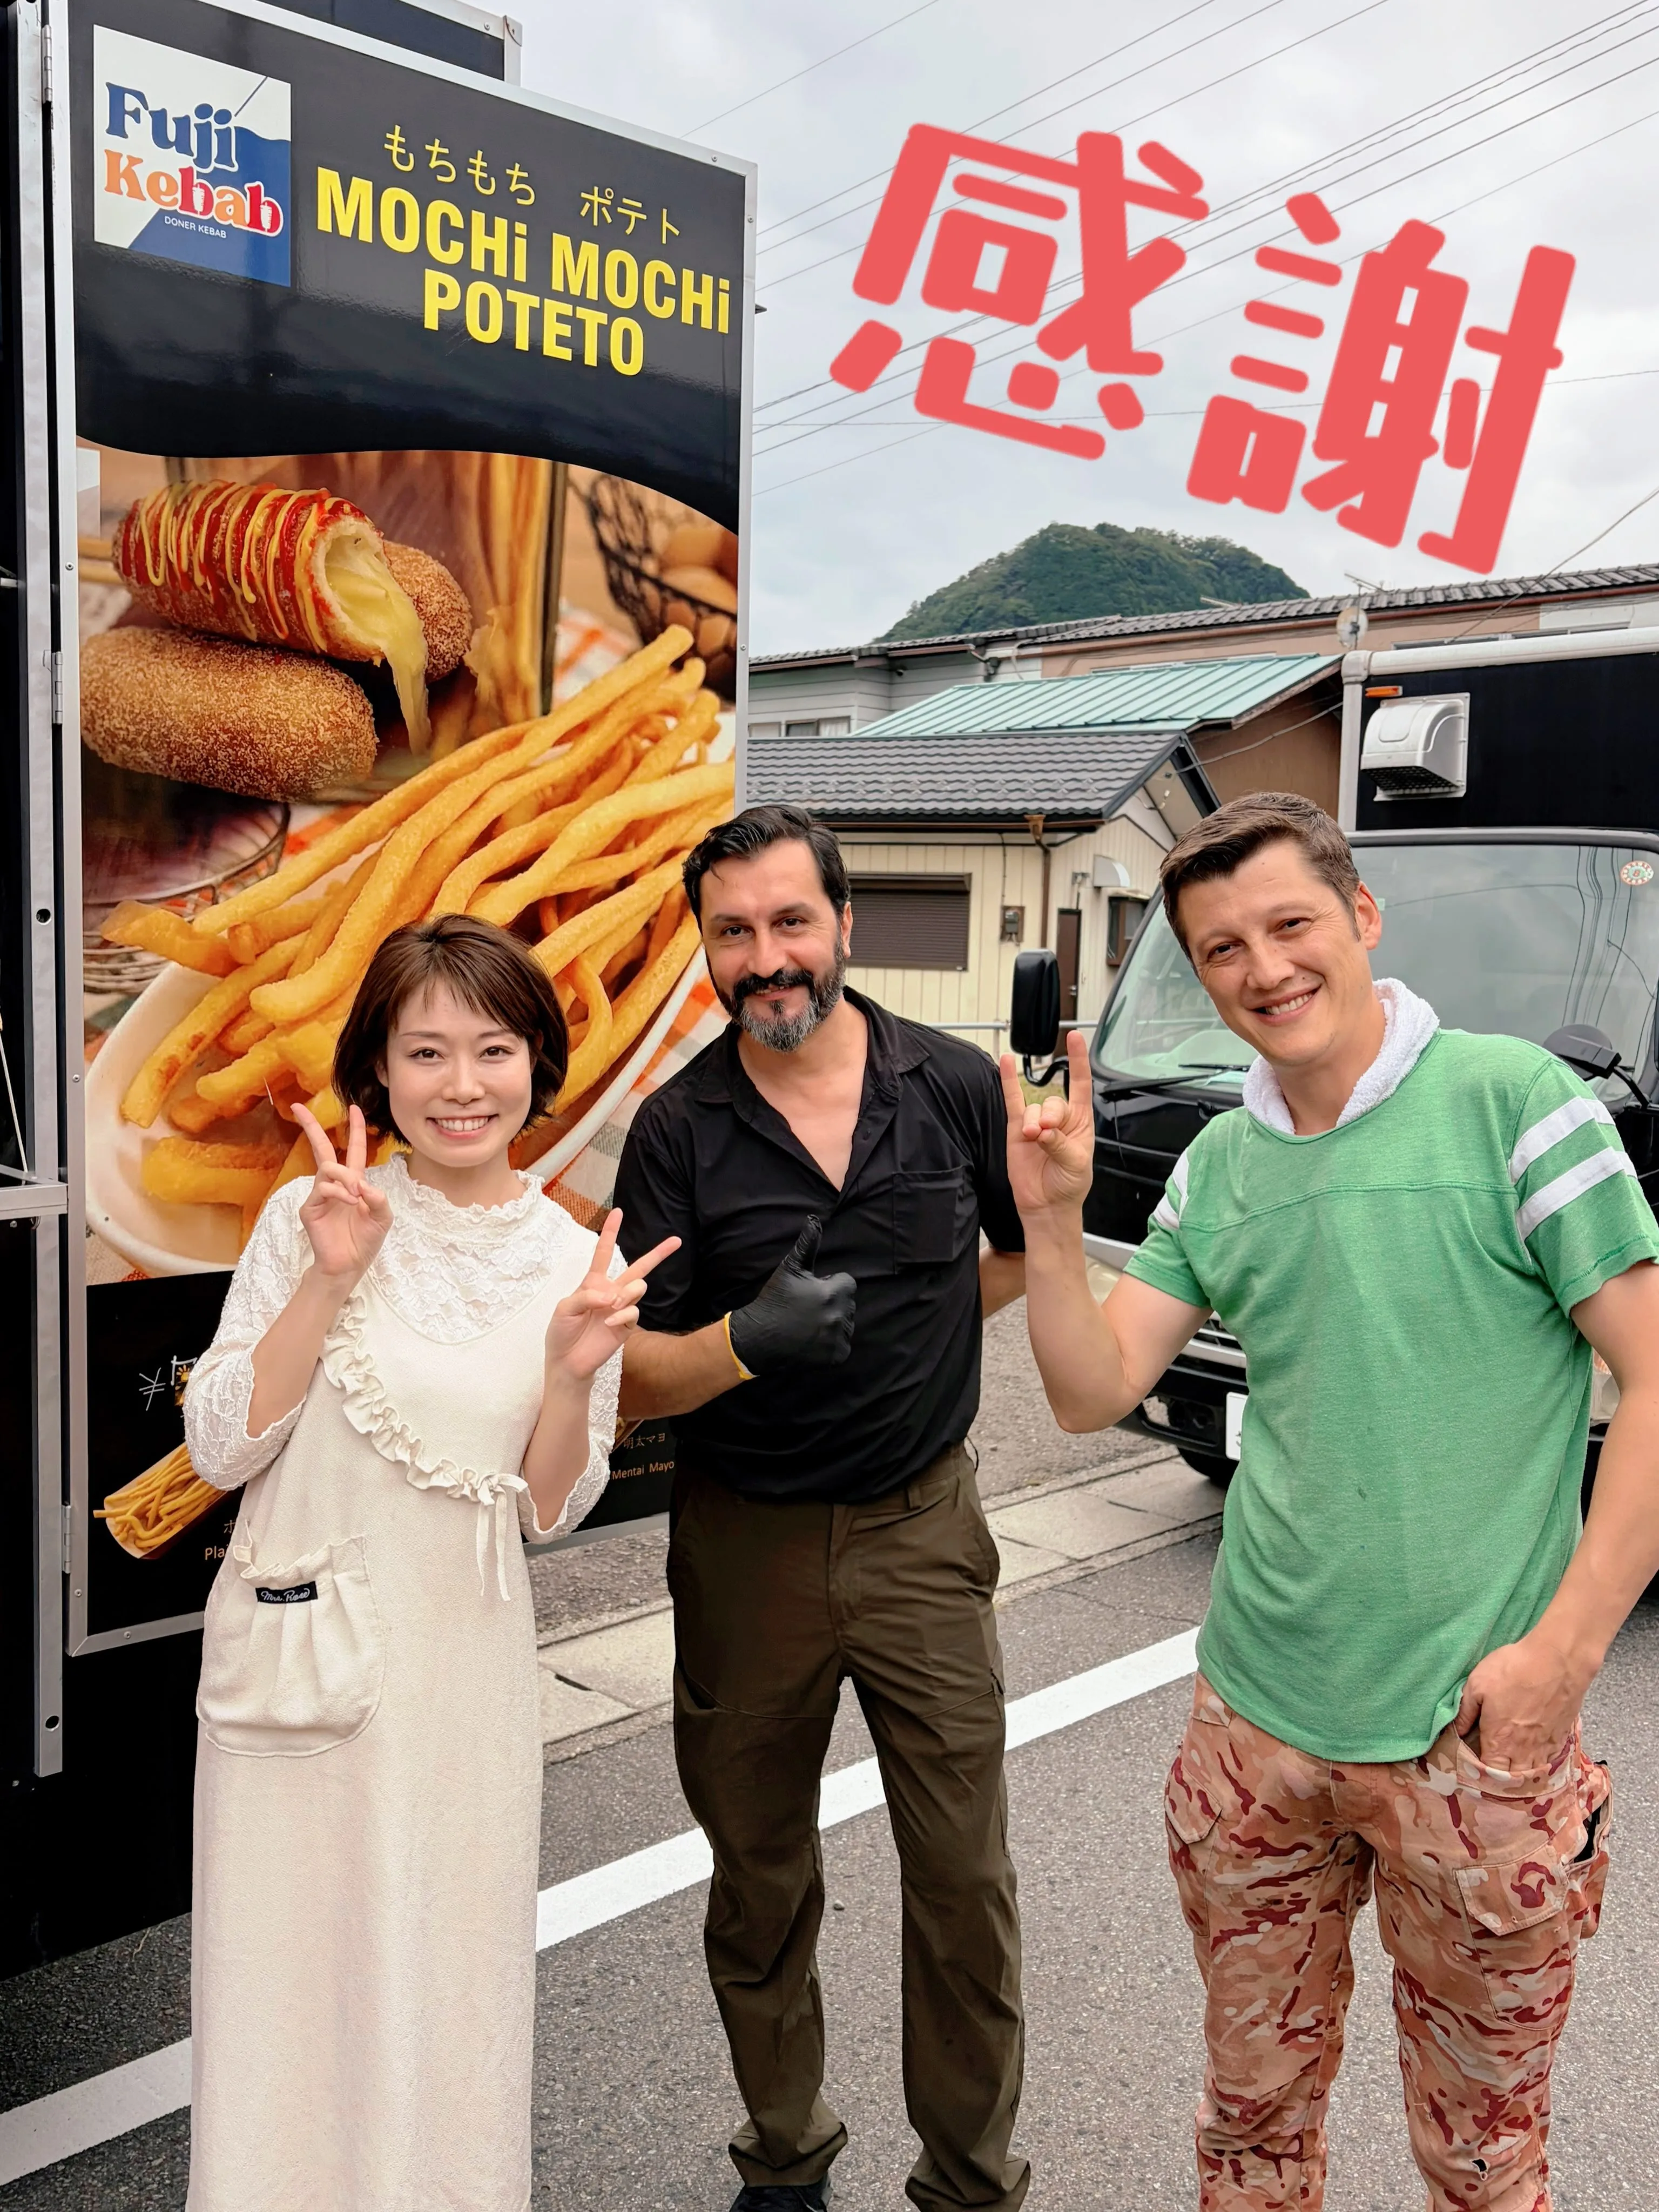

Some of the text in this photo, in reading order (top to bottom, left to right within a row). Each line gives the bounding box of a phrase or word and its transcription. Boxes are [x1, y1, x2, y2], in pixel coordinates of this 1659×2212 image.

[105, 82, 237, 172] Fuji
[104, 149, 284, 234] Kebab
[384, 124, 680, 244] もちもち ポテト
[164, 215, 227, 239] DONER KEBAB
[424, 269, 644, 376] POTETO
[624, 1433, 665, 1449] 明太マヨ
[612, 1461, 675, 1480] Mentai Mayo
[261, 1588, 310, 1602] Mrs. Rose
